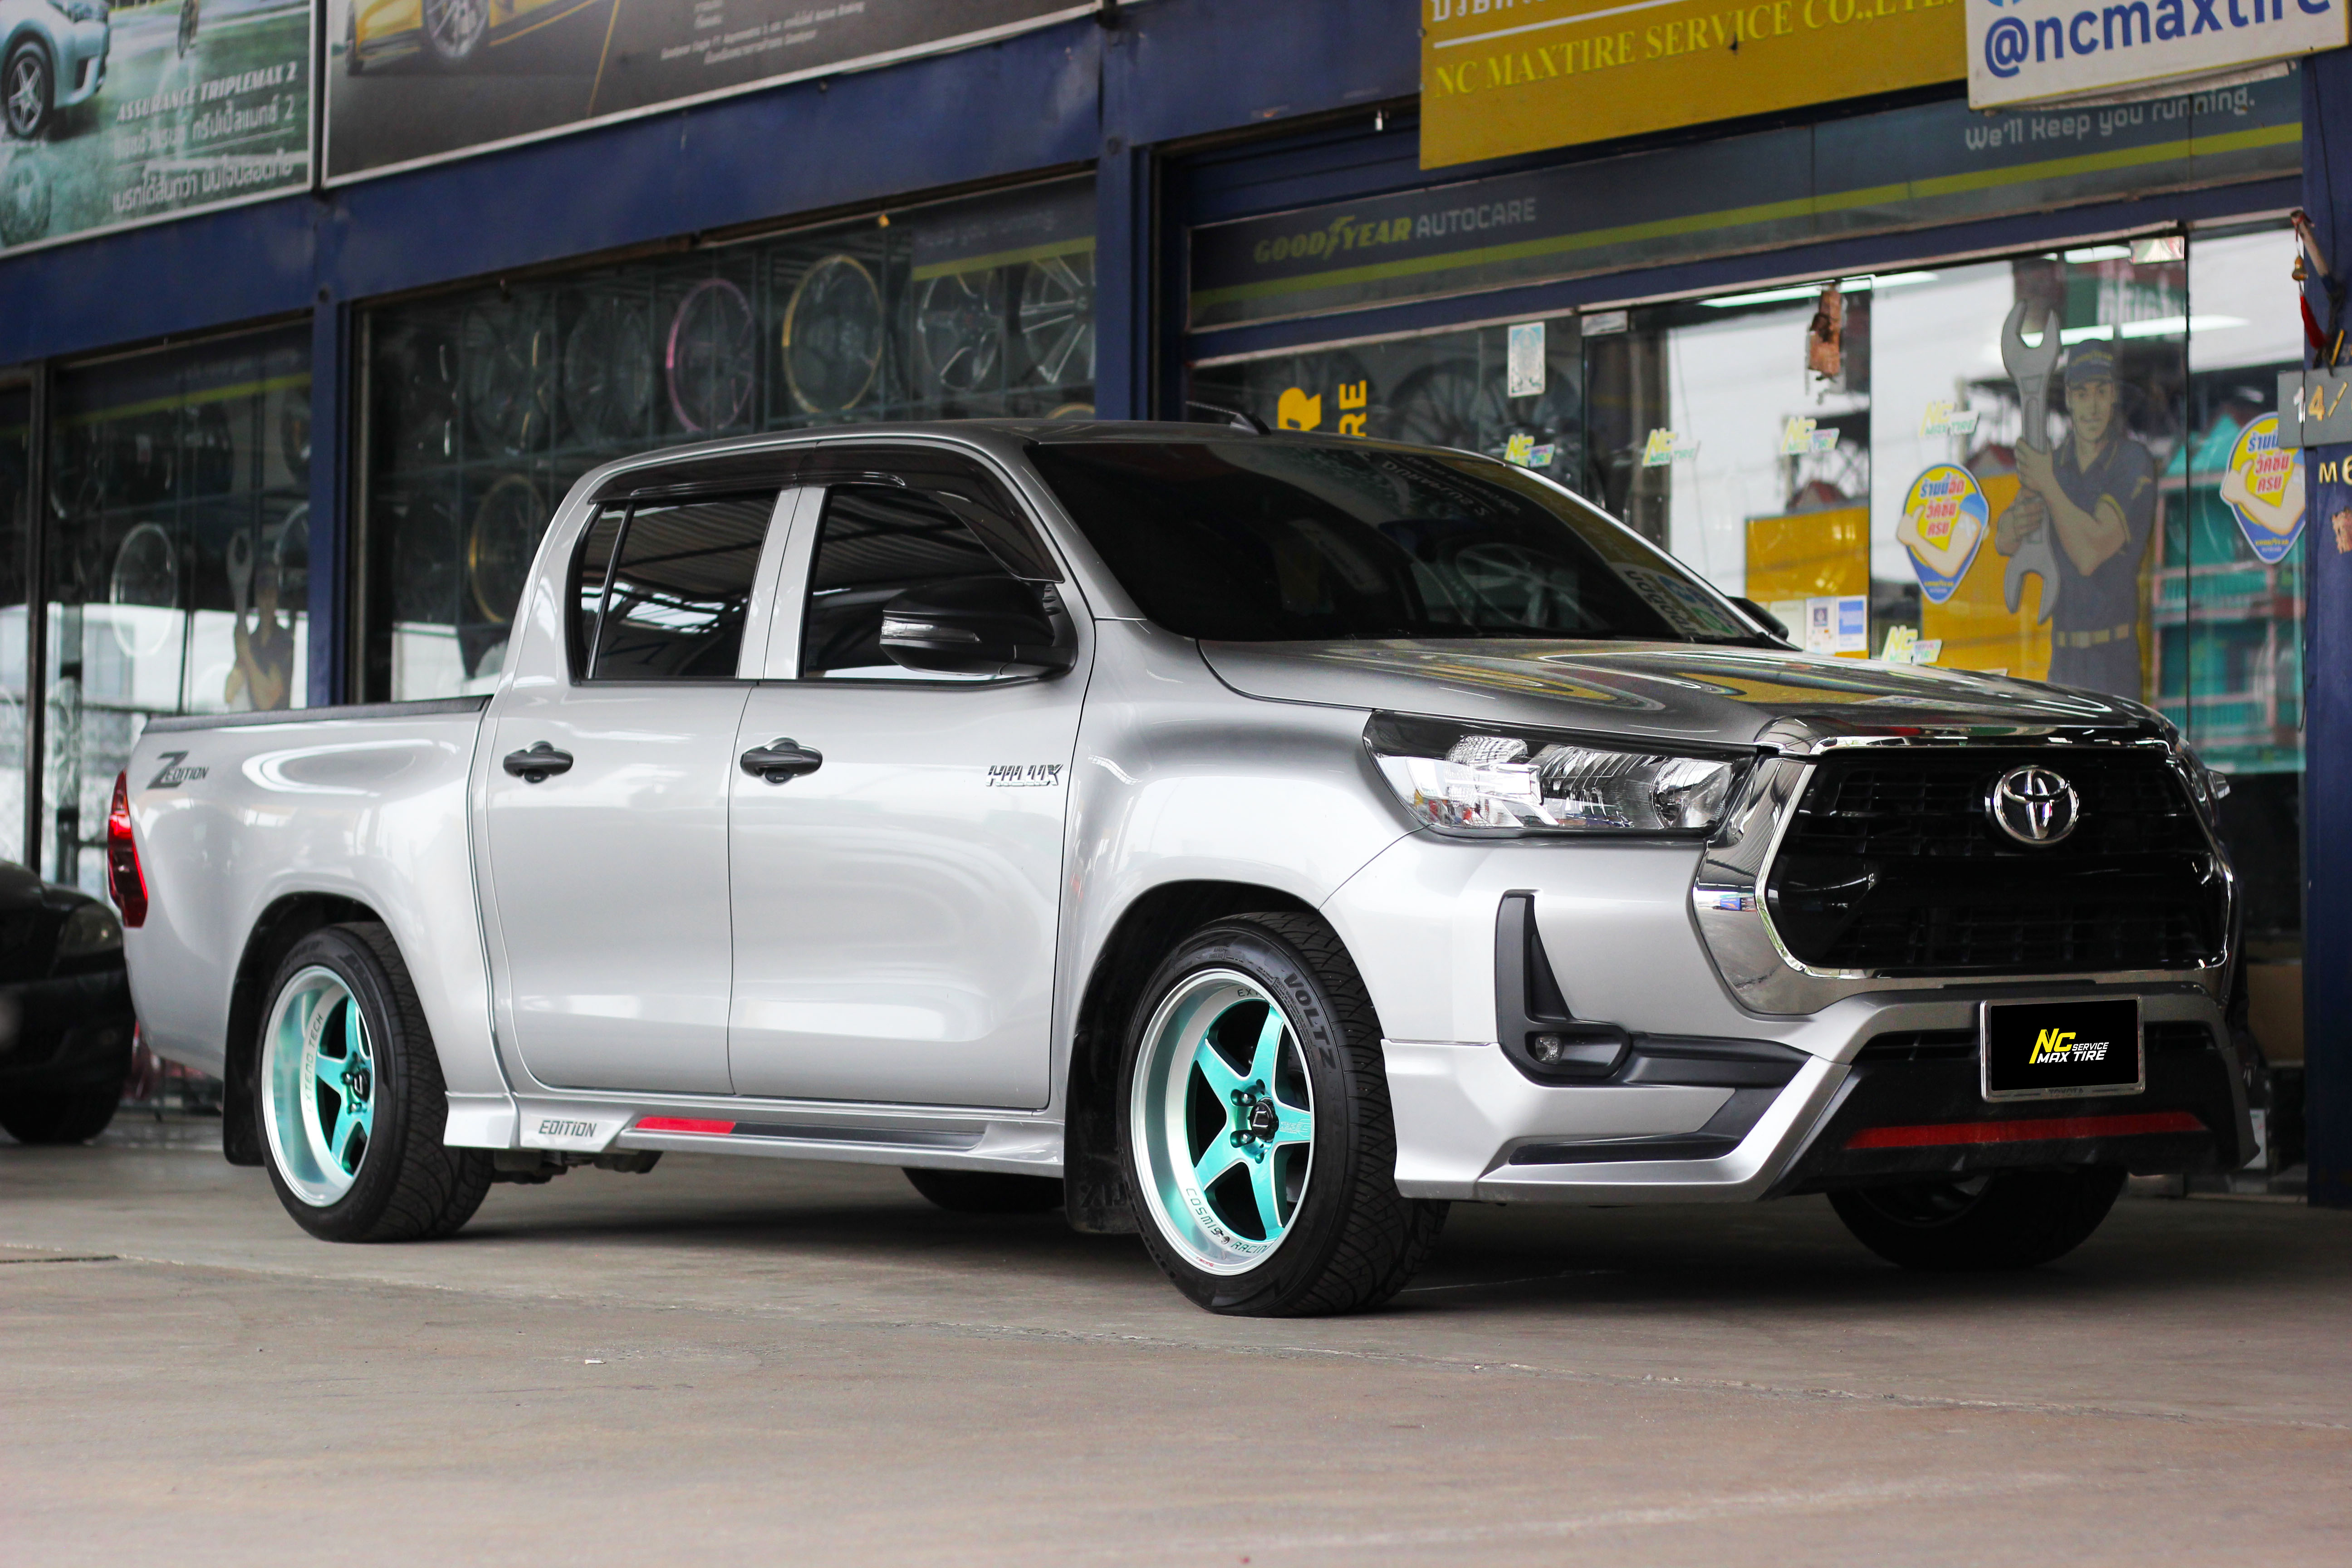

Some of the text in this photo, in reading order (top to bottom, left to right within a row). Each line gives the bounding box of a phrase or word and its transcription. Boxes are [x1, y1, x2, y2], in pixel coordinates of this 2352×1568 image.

[1435, 62, 1478, 98] NC
[1486, 32, 1635, 89] MAXTIRE
[1646, 1, 1793, 60] SERVICE
[117, 61, 298, 122] ASSURANCE TRIPLEMAX 2
[284, 94, 295, 120] 2
[1965, 117, 2024, 150] We'll
[2099, 103, 2144, 136] you
[2152, 86, 2256, 122] running.
[1254, 198, 1536, 263] GOODYEAR AUTOCARE
[1919, 401, 1953, 436] NC
[2293, 382, 2352, 424] 14/
[1643, 428, 1677, 464] NC
[1782, 416, 1816, 452] NC
[2257, 476, 2283, 493] ครบ
[1884, 627, 1917, 660] NC
[147, 751, 209, 789] Z EDITION
[985, 764, 1063, 787] HILUX
[308, 1013, 323, 1048] TECH
[1284, 973, 1337, 1069] VOLTZ
[539, 1120, 596, 1137] EDITION
[1186, 1188, 1224, 1236] COSMIS
[1231, 1241, 1270, 1254] RACIN
